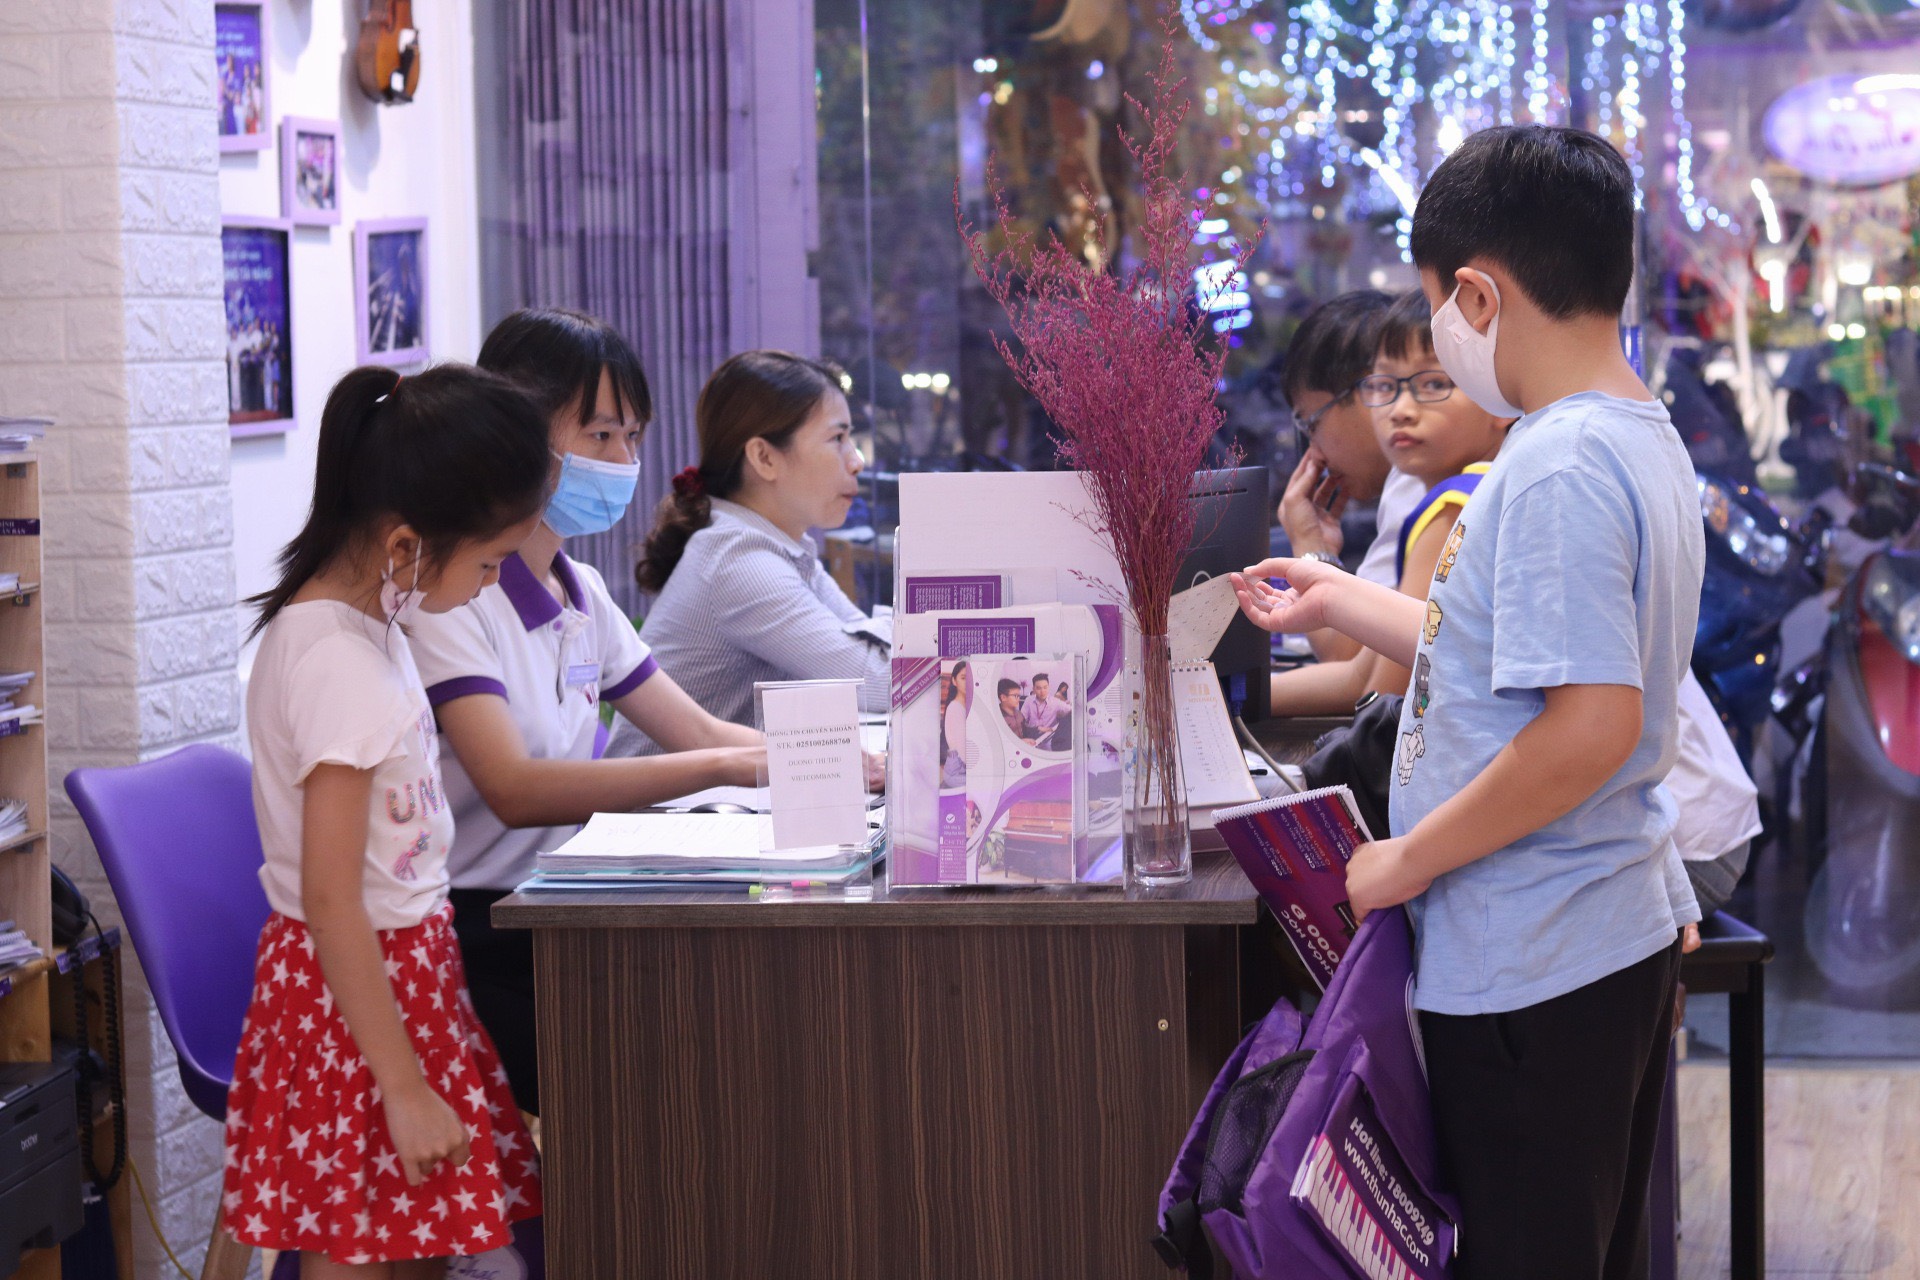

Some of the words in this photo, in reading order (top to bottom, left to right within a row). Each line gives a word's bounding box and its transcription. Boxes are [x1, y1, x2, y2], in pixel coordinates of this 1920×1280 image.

[776, 742, 795, 750] STK:
[791, 772, 842, 782] VIETCOMBANK
[1280, 909, 1306, 939] HỌC
[1344, 1137, 1429, 1267] www.thunhac.com
[1387, 1175, 1435, 1246] 18009249
